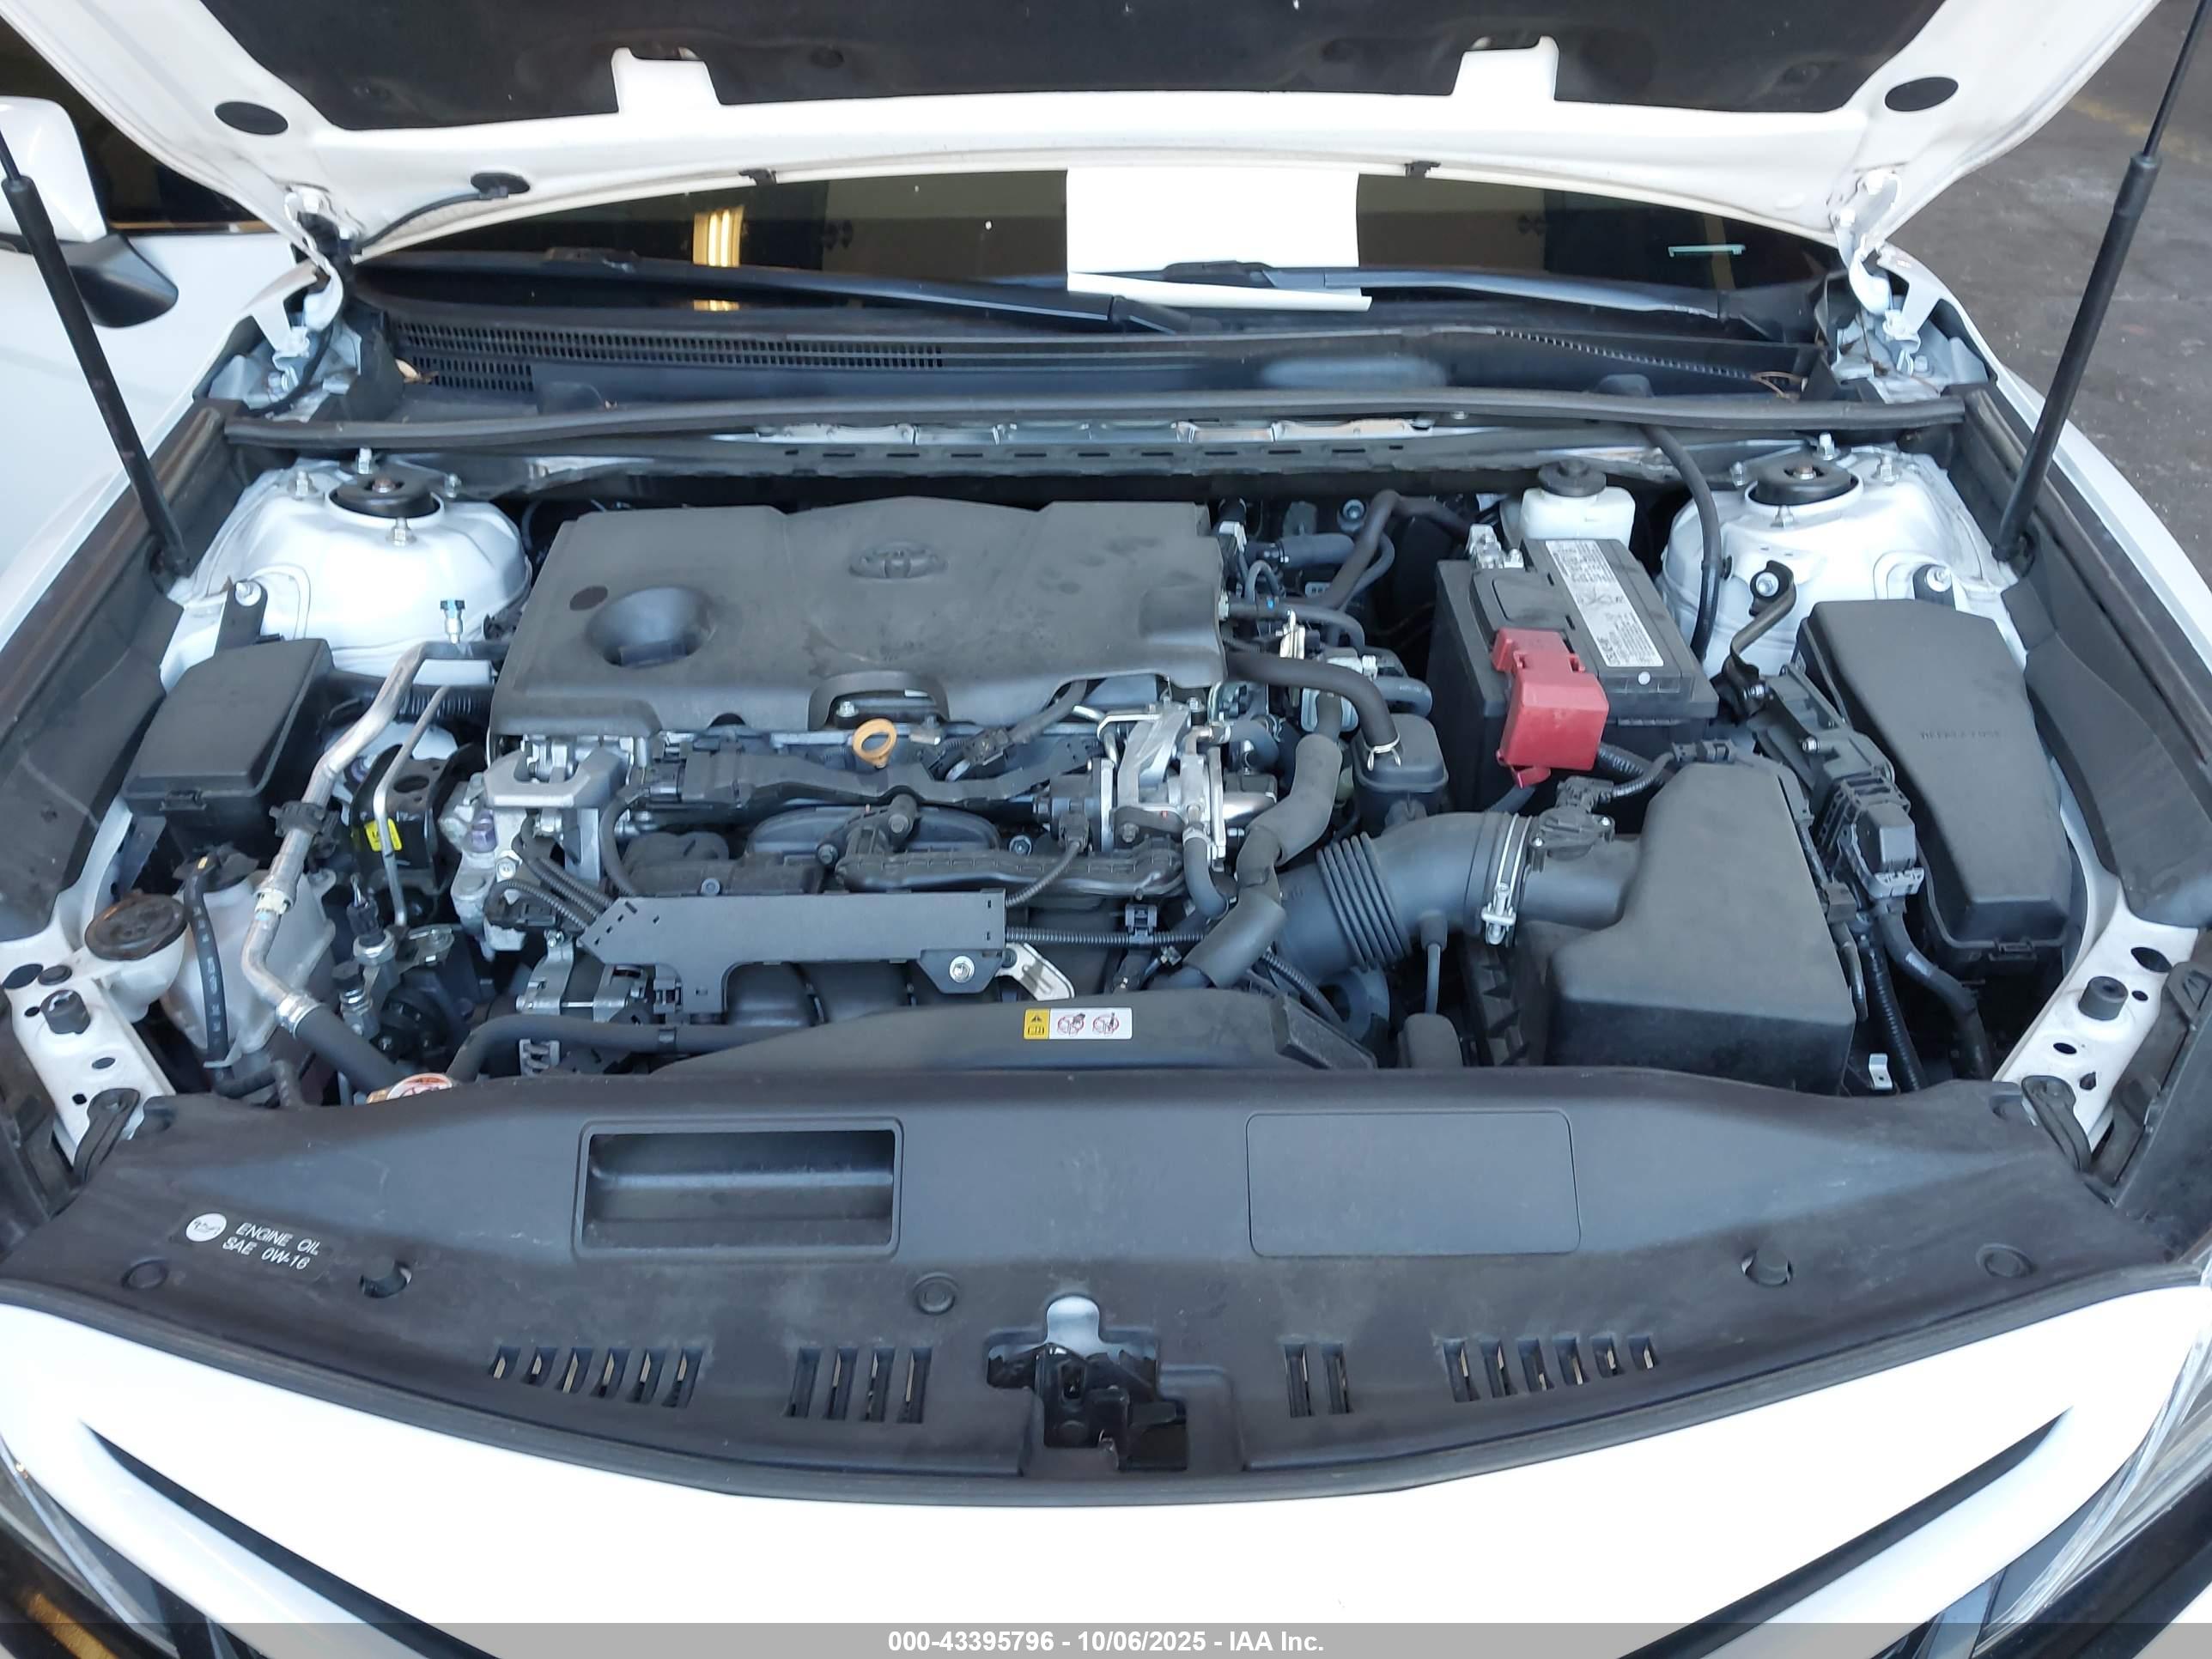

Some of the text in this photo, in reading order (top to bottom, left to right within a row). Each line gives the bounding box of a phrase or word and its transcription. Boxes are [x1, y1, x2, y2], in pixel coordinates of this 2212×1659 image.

[222, 1236, 311, 1270] SAE 0W-16
[235, 1222, 321, 1255] ENGINE OIL
